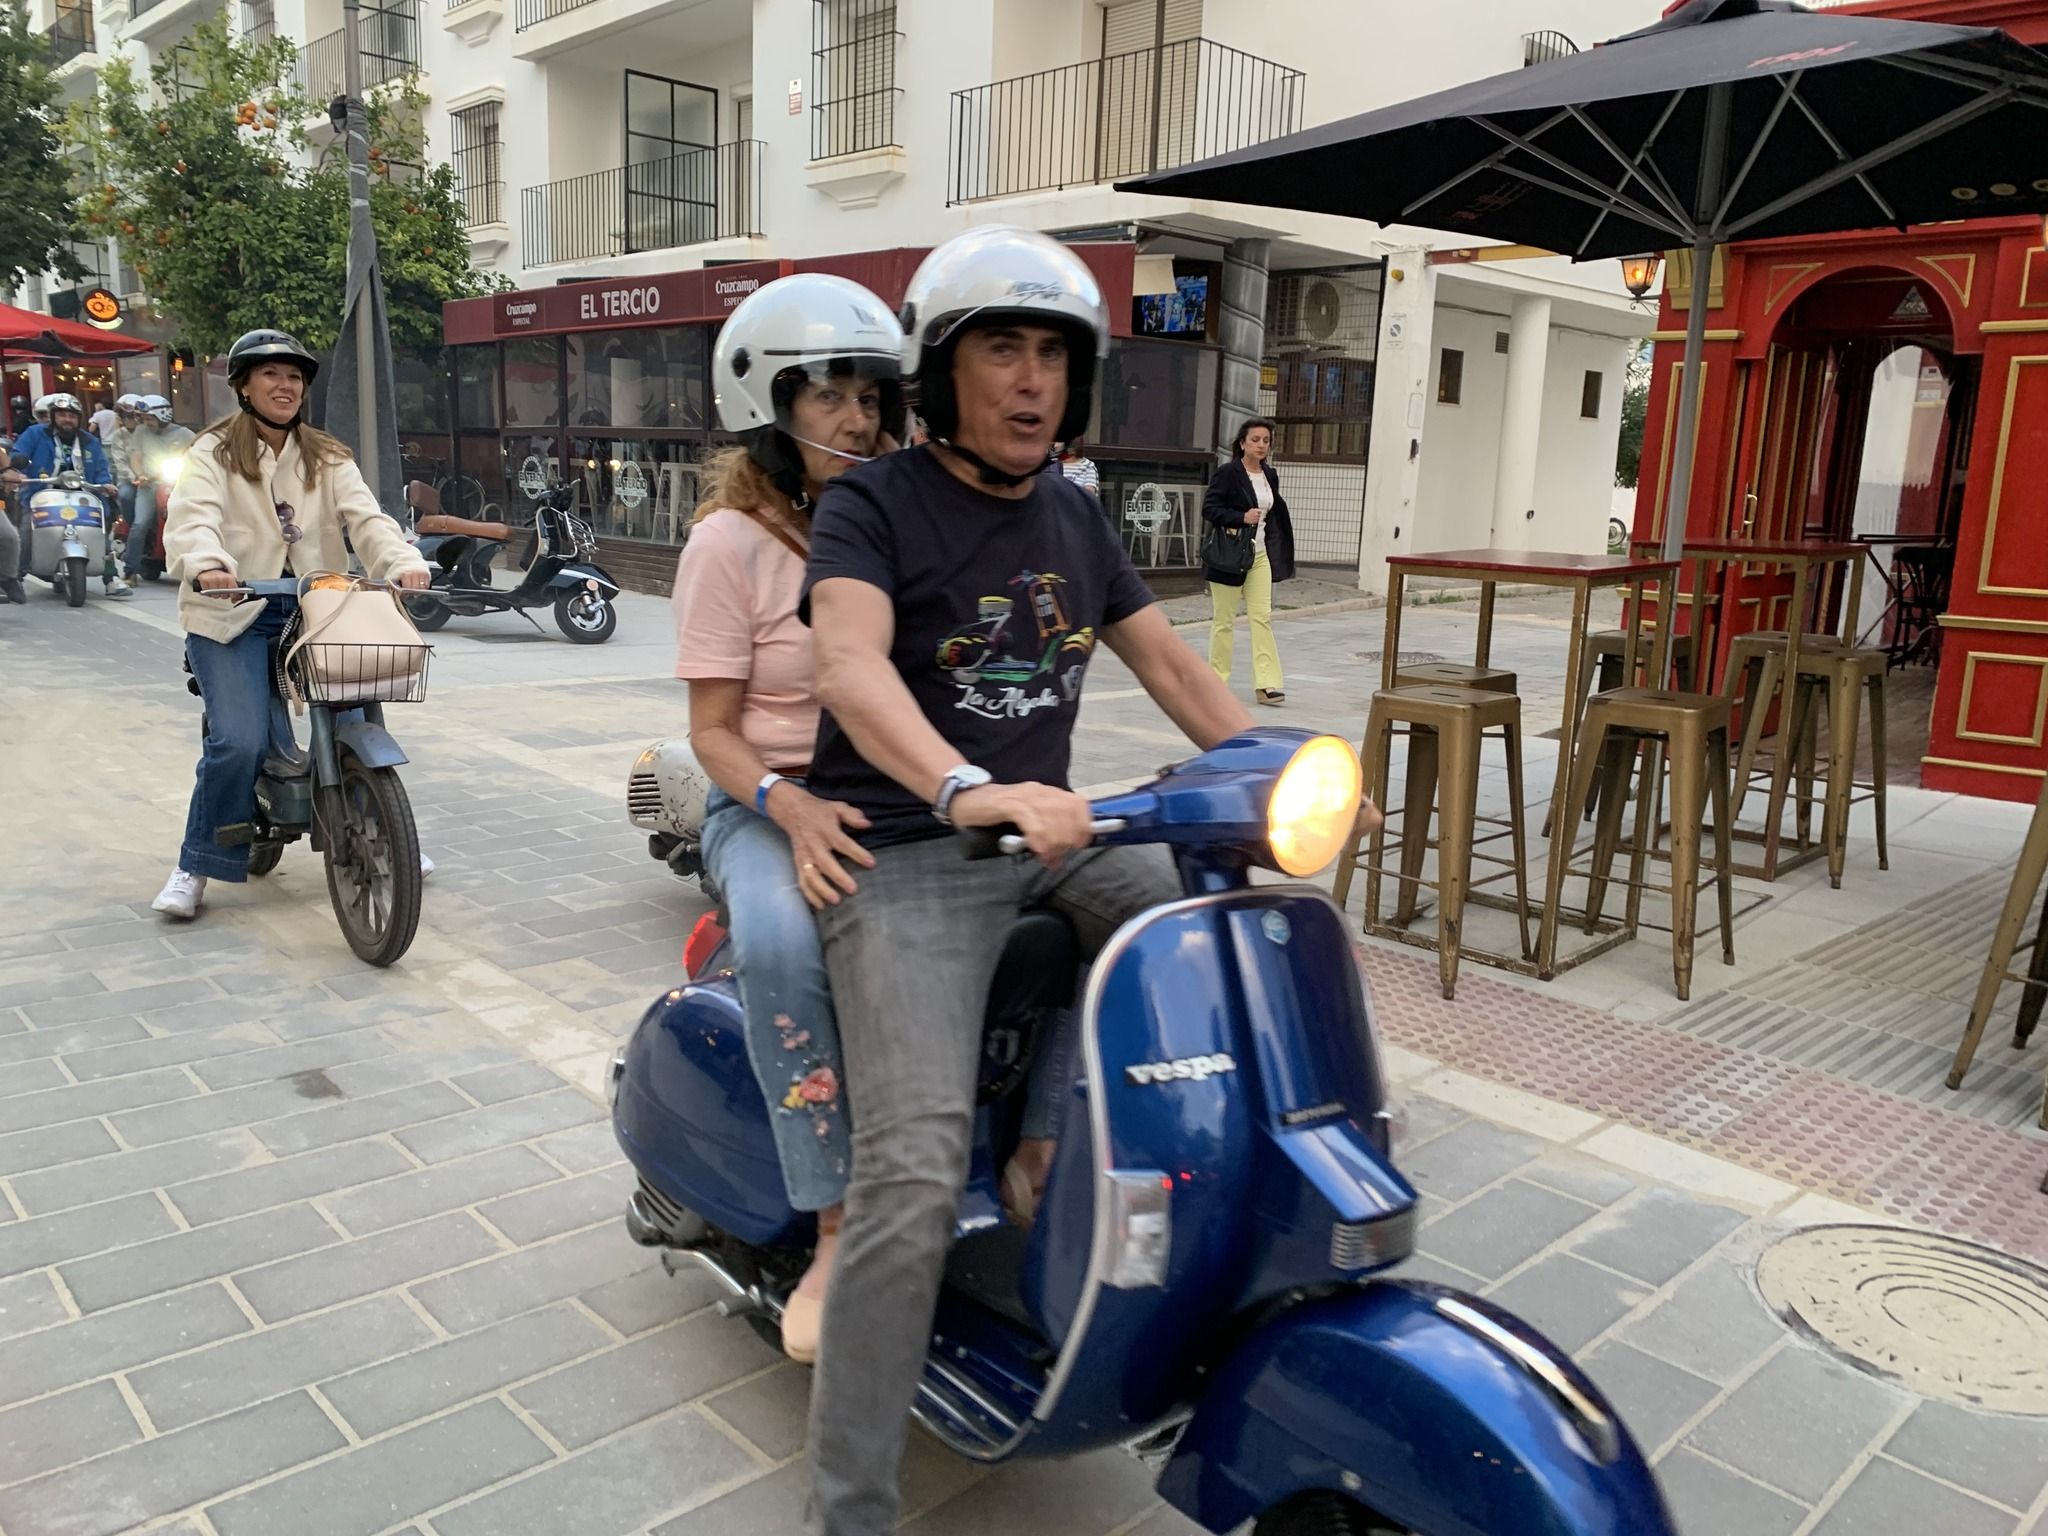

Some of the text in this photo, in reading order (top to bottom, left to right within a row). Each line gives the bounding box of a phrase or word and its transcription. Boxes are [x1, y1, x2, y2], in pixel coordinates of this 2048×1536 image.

[715, 278, 759, 295] Cruzcampo
[580, 286, 660, 320] EL TERCIO
[723, 296, 747, 307] ESPECI
[506, 302, 537, 316] Cruzcampo
[512, 317, 531, 326] ESPECIAL
[1126, 500, 1171, 513] EL TERCIO
[1125, 1053, 1236, 1084] vespa
